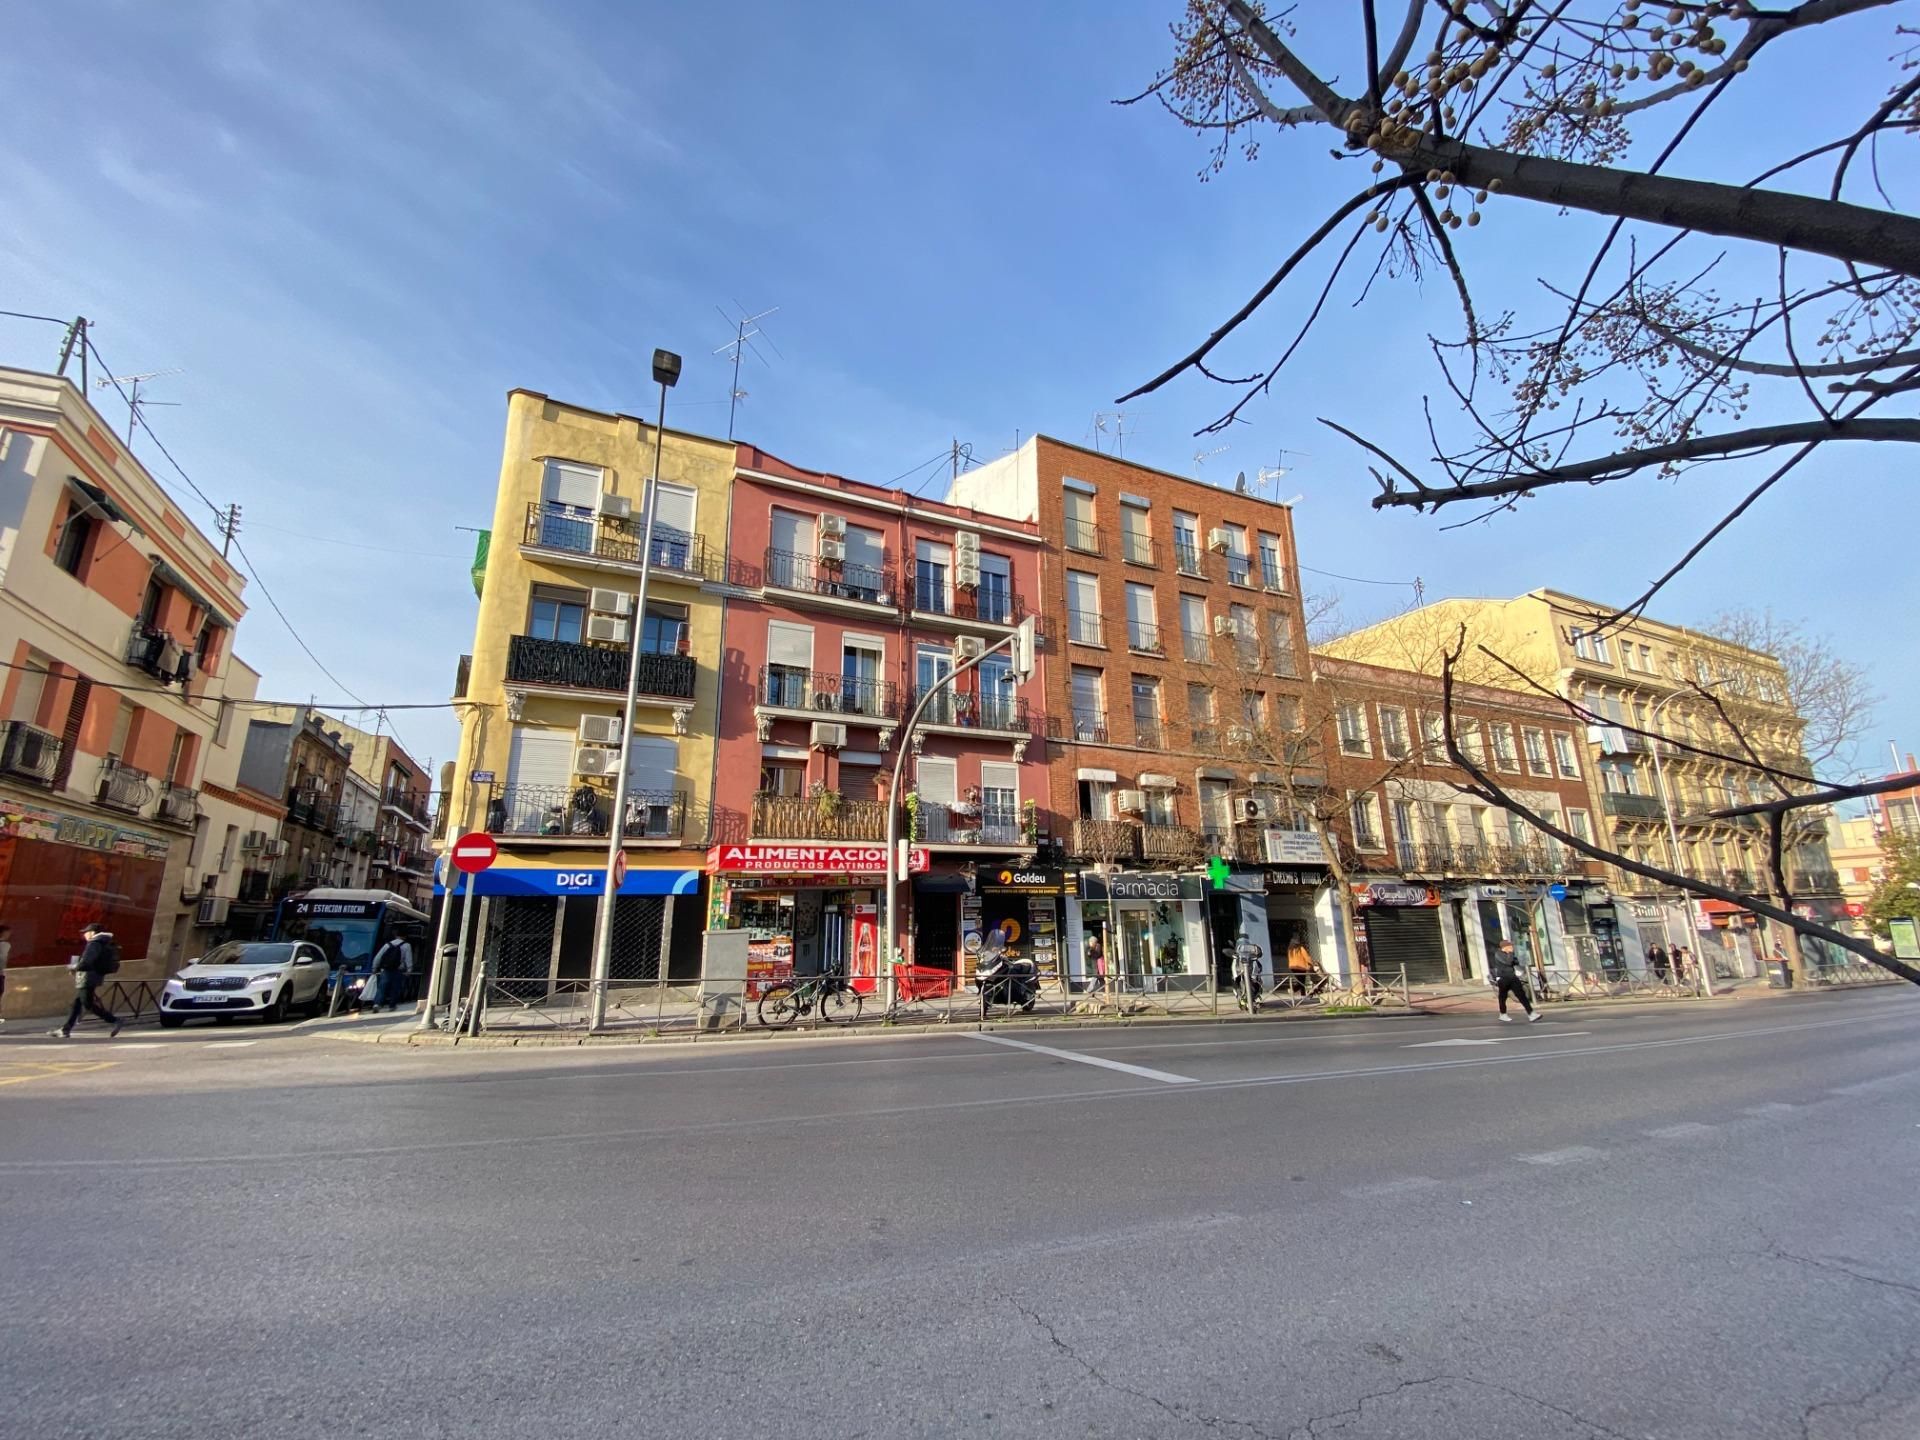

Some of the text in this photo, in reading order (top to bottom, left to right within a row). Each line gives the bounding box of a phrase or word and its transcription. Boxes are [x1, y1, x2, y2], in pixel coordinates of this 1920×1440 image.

[57, 818, 117, 850] HAPPY
[745, 861, 881, 870] PRODUCTOS LATINOS
[556, 873, 593, 886] DIGI
[1013, 872, 1046, 884] Goldeu
[1110, 881, 1179, 896] farmacia
[297, 903, 365, 913] 24 ESTACION ATOCHA
